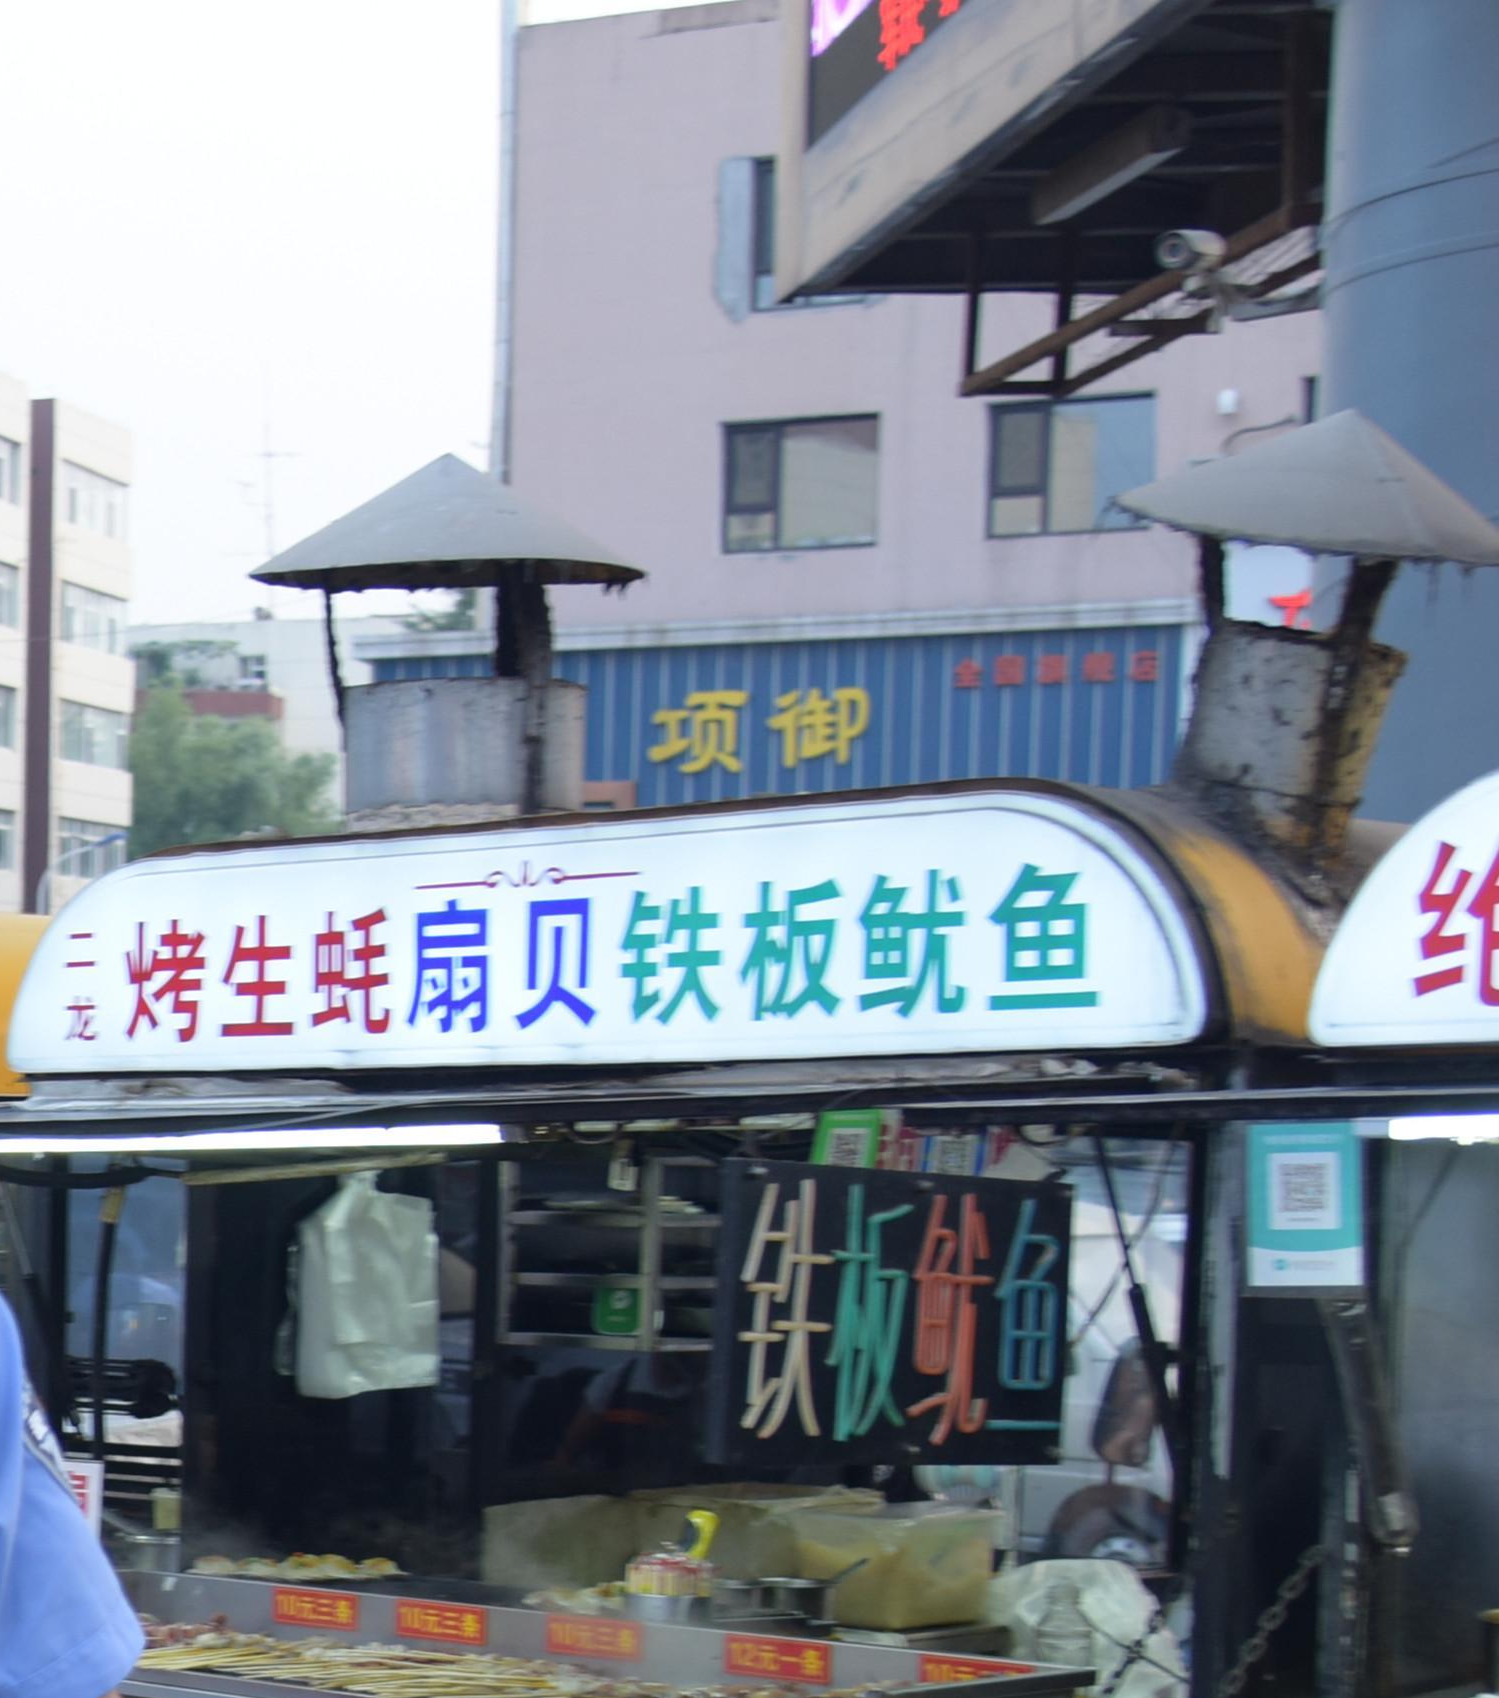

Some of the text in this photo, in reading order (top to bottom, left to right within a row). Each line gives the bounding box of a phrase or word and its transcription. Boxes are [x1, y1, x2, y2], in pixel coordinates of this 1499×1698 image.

[647, 686, 870, 773] 项御
[737, 1178, 1061, 1446] 铁板鱿鱼
